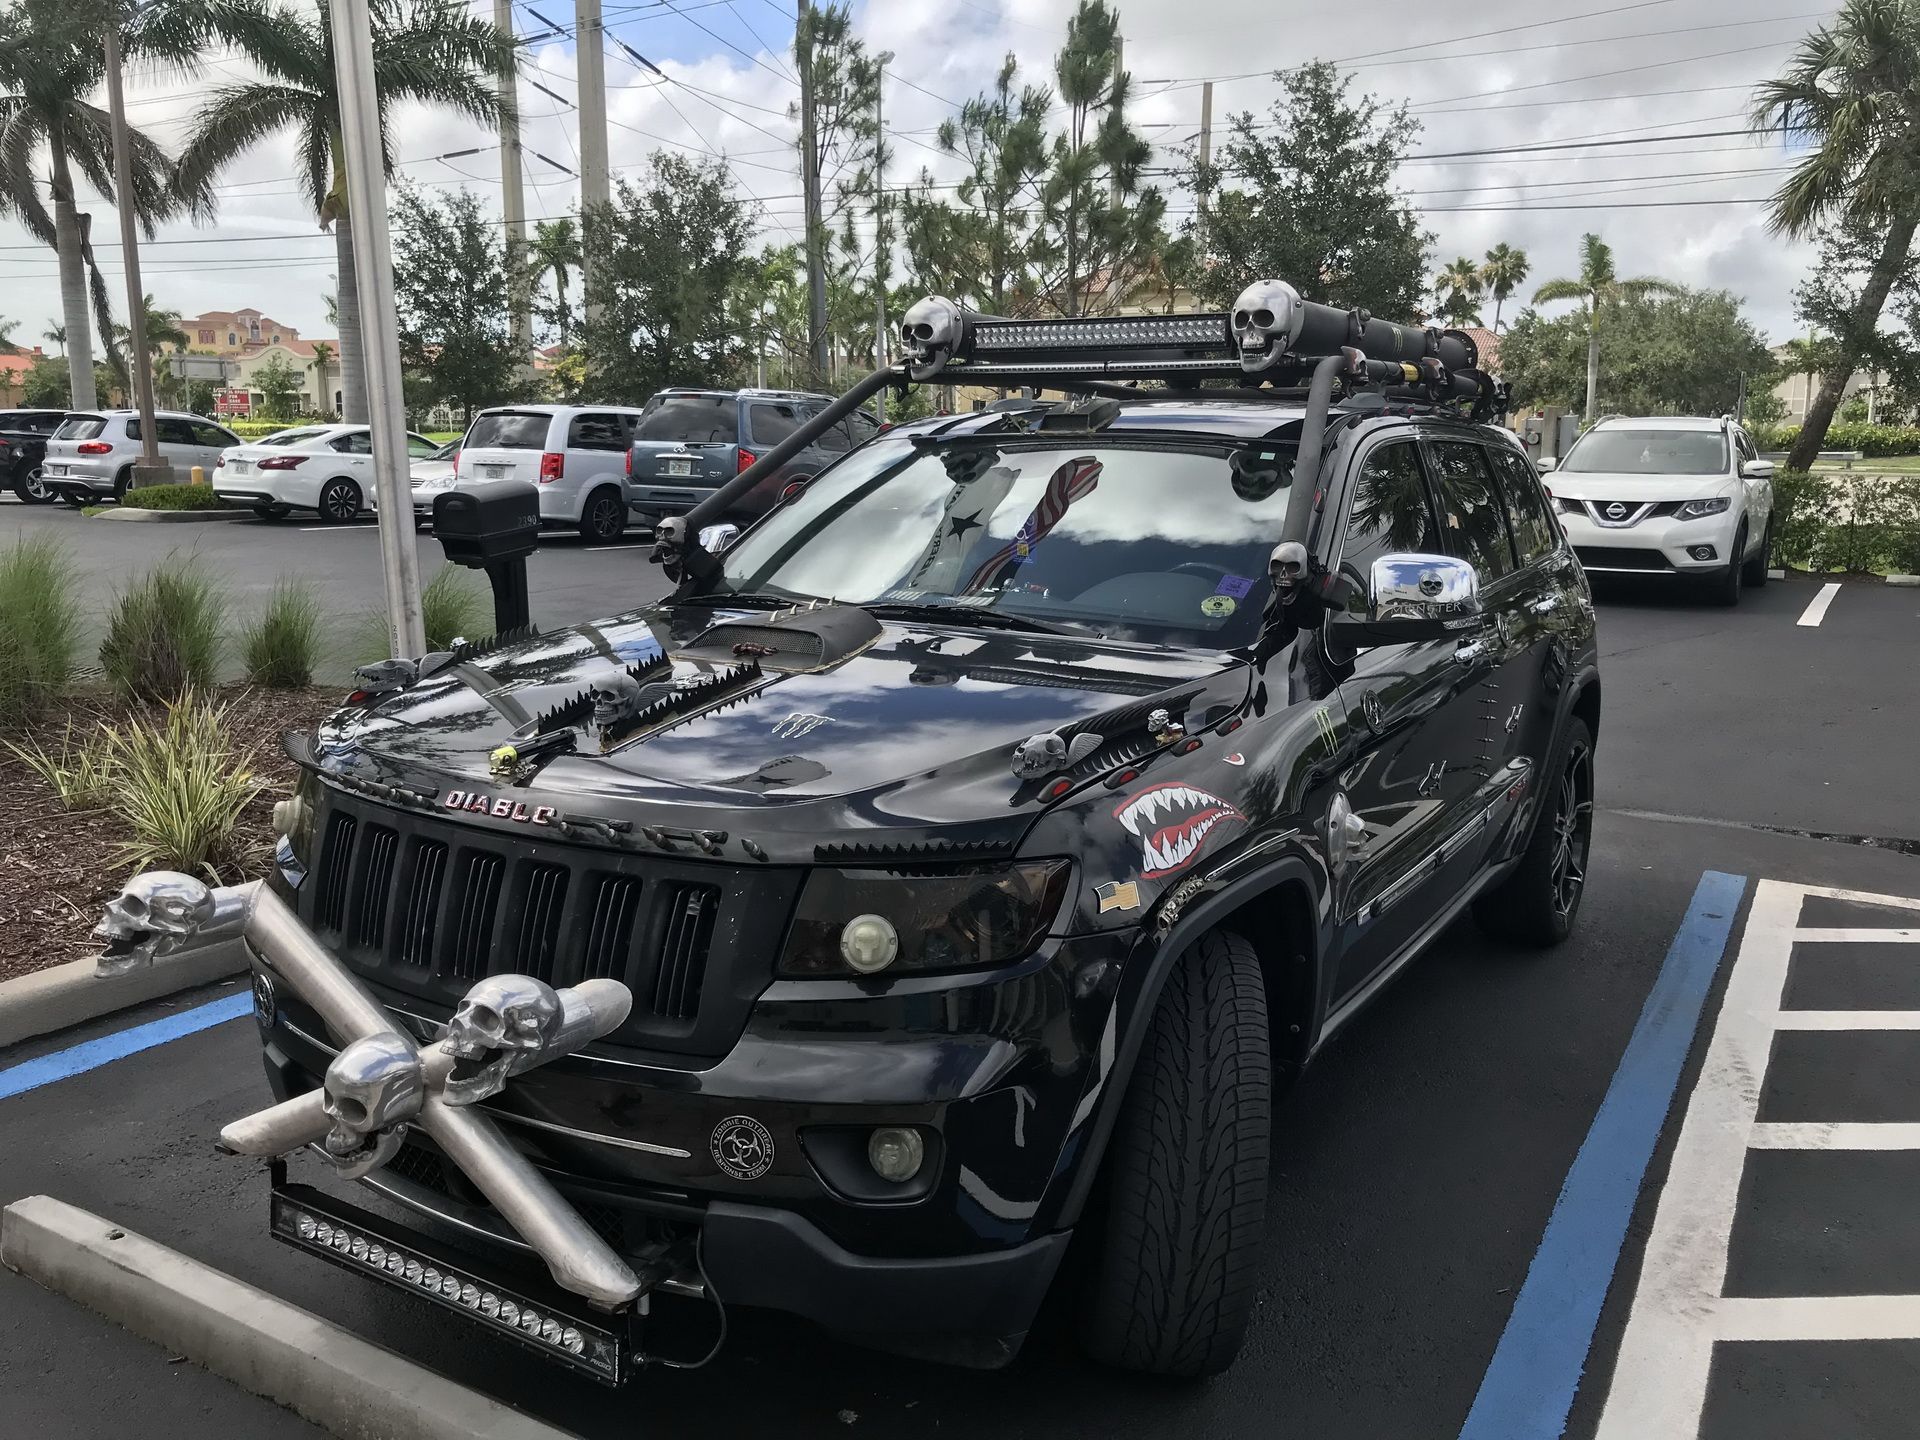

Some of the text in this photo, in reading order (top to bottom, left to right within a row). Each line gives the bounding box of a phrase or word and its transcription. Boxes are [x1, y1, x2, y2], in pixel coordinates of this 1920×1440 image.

[1390, 601, 1462, 616] MONSTER
[714, 1118, 772, 1155] ZOMBIE OUTBREAK
[713, 1149, 767, 1178] RESPONSE TEAM
